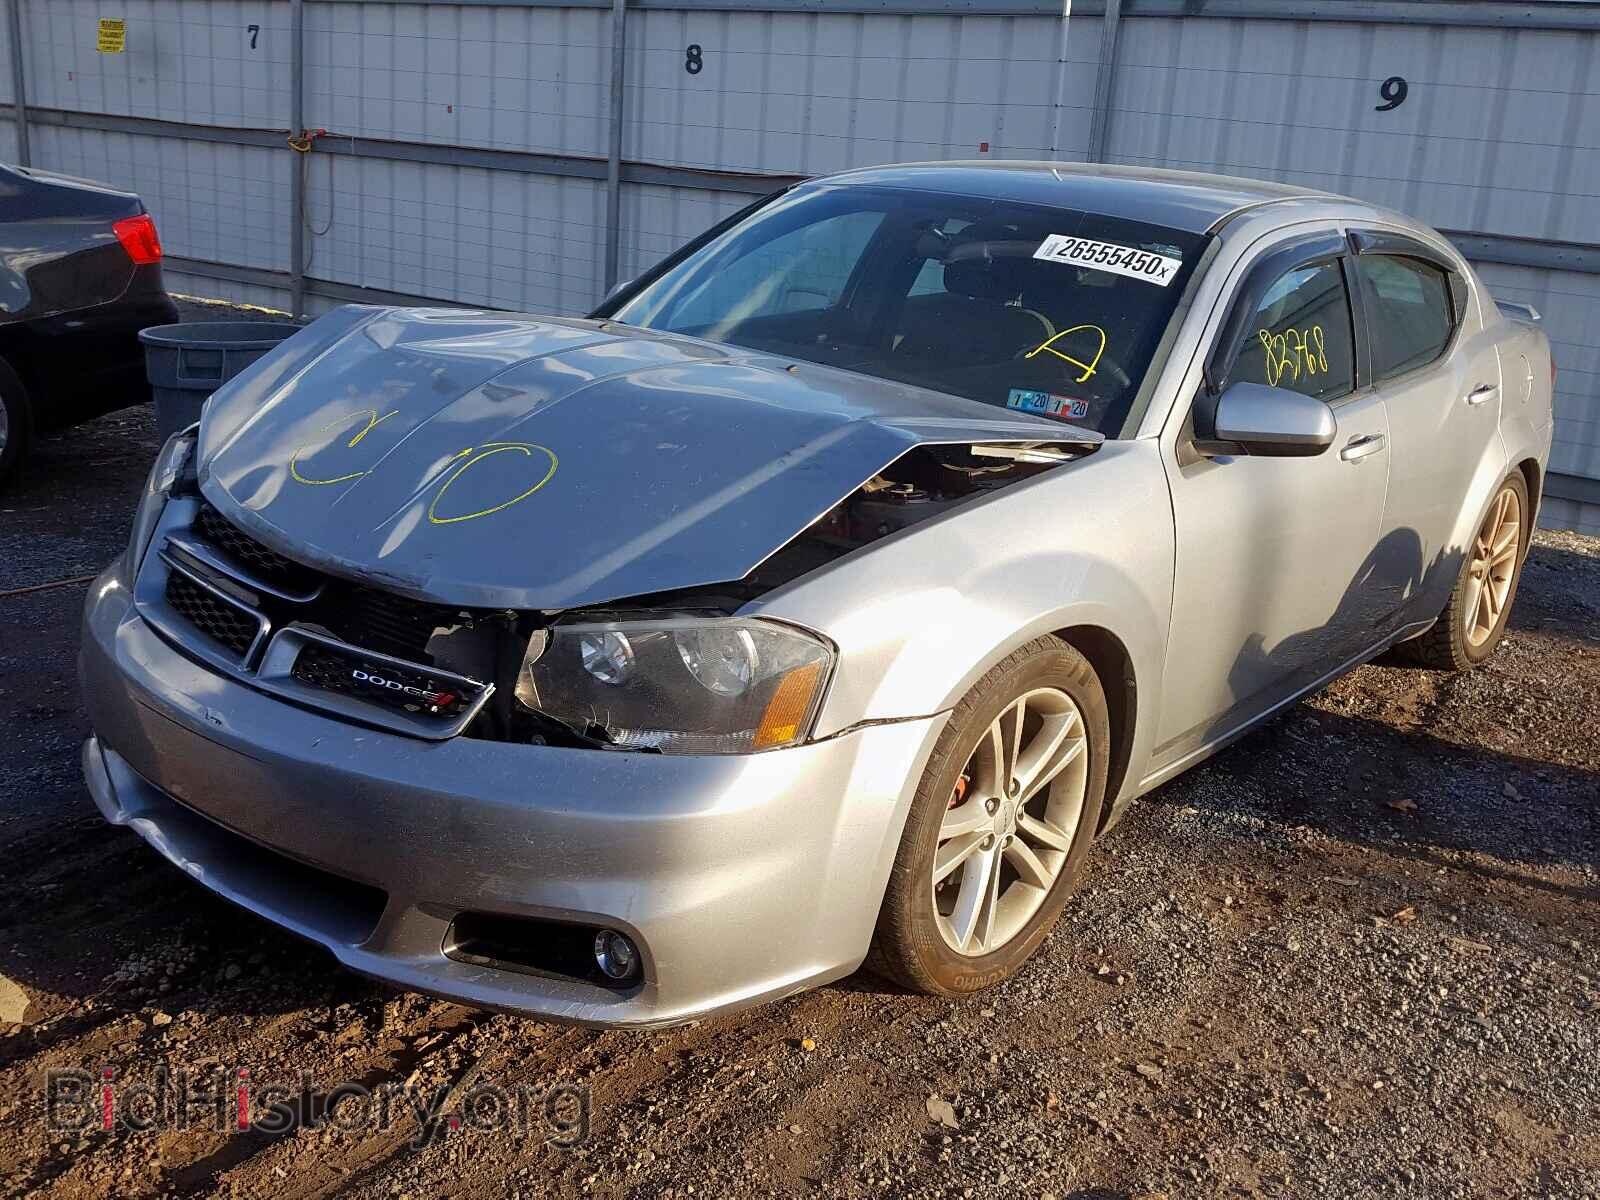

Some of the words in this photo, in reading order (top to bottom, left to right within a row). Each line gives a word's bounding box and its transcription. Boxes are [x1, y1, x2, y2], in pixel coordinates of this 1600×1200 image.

[247, 25, 260, 50] 7
[685, 44, 703, 75] 8
[1375, 76, 1409, 112] 9
[1034, 394, 1047, 408] 20
[1073, 401, 1086, 416] 20
[352, 669, 441, 703] DODGE
